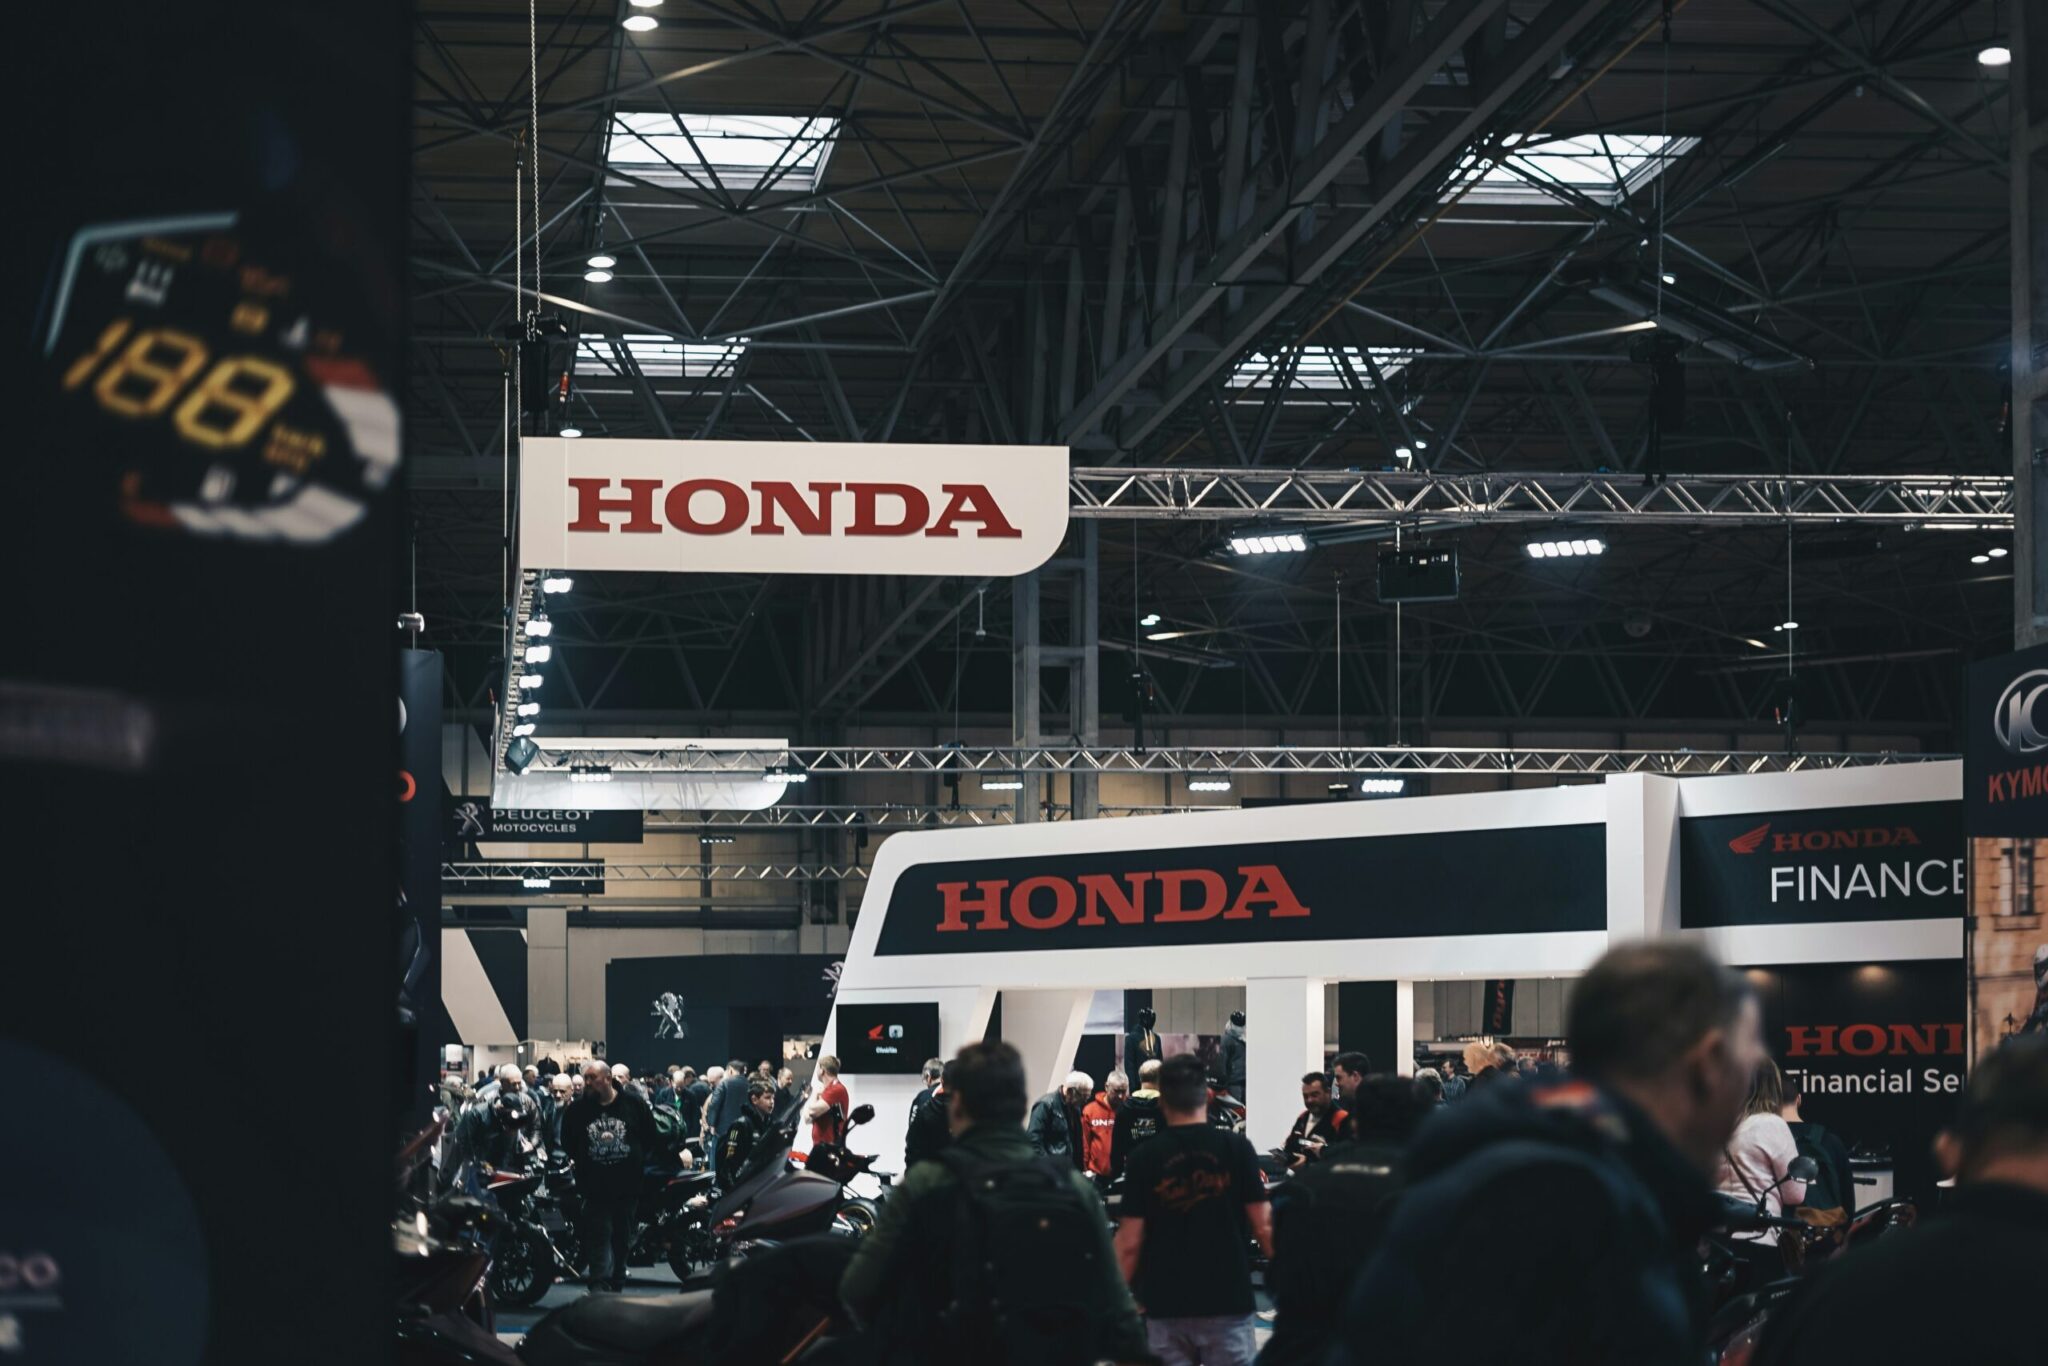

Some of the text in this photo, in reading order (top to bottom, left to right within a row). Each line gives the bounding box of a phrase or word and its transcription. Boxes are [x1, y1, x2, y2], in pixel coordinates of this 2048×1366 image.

[567, 477, 1023, 538] HONDA
[492, 808, 595, 821] PEUGEOT
[492, 823, 577, 833] MOTOCYCLES
[1772, 826, 1922, 852] HONDA
[936, 864, 1311, 932] HONDA
[1923, 1068, 1965, 1093] Se
